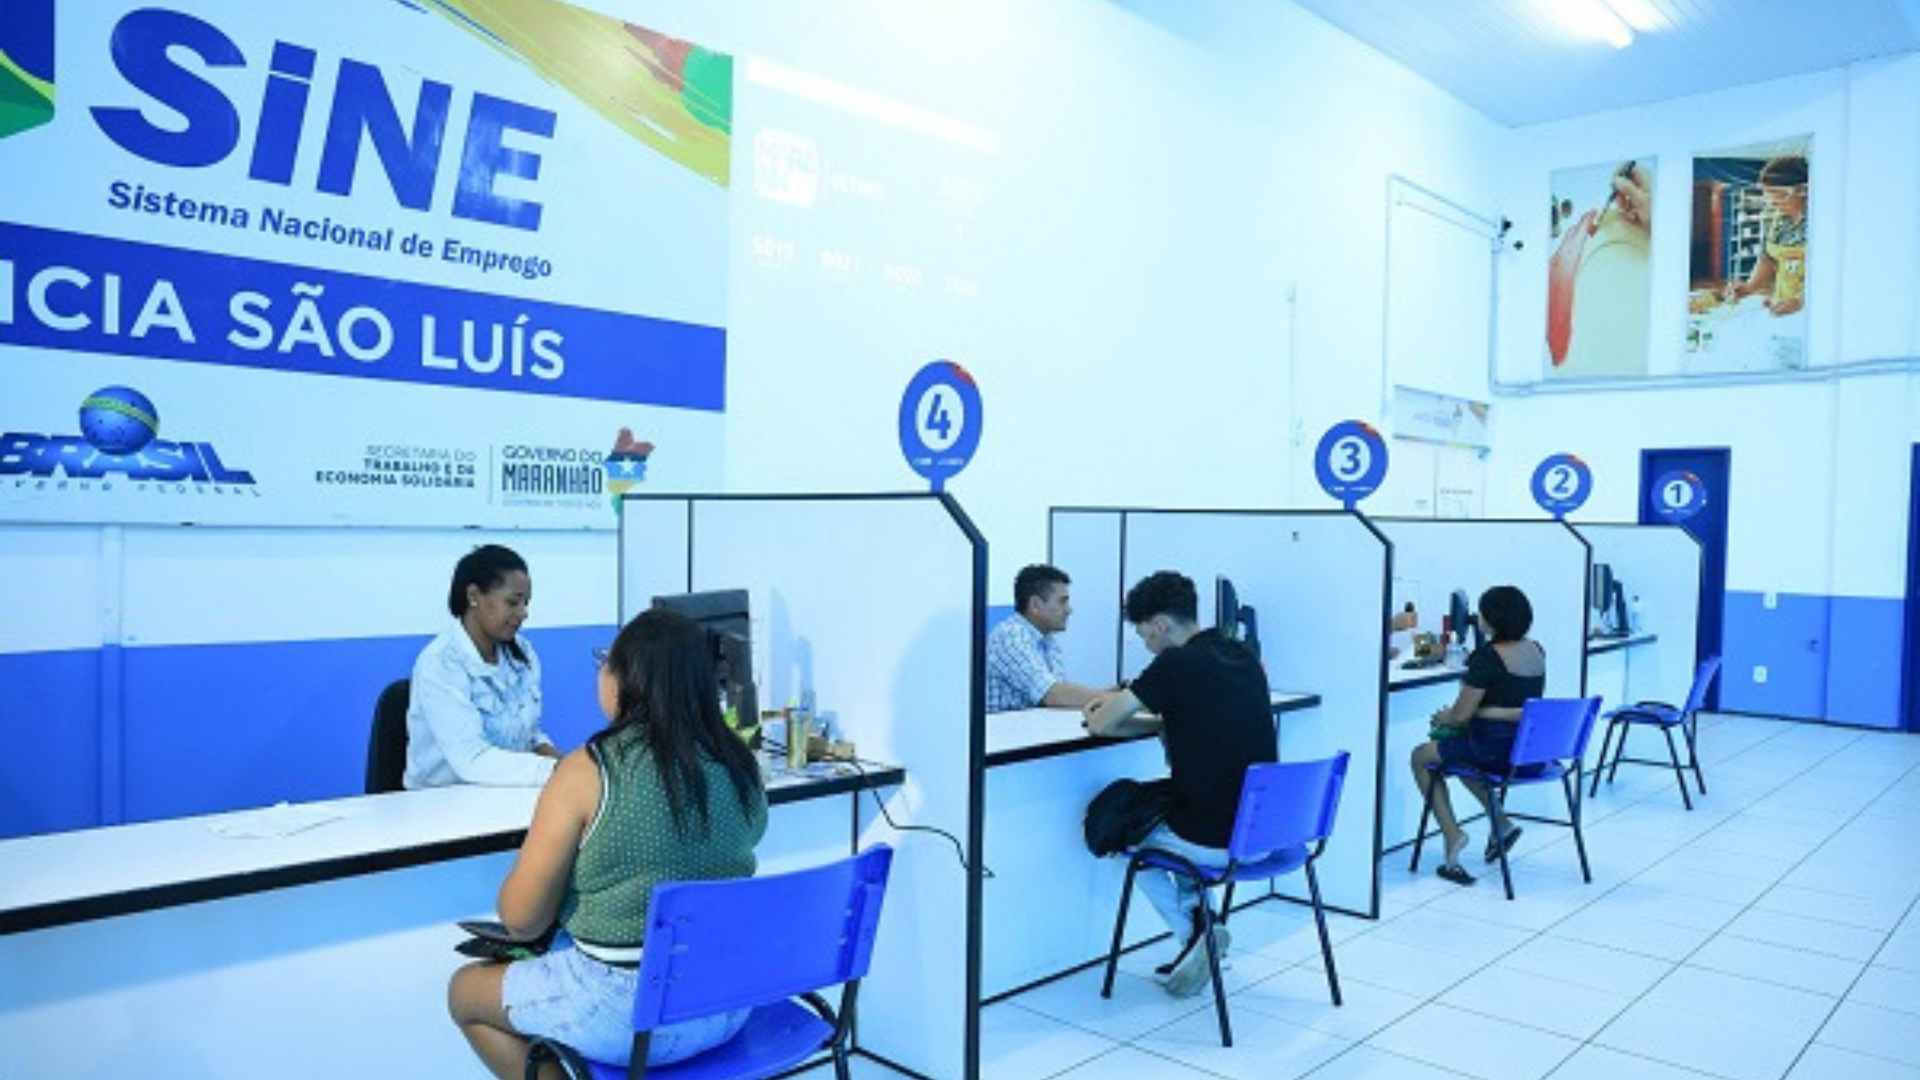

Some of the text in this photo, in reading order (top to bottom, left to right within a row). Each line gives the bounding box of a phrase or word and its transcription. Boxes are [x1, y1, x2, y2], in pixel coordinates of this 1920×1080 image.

[108, 181, 552, 279] Sistema Nacional de Emprego
[0, 259, 564, 379] CIA SÃO LUÍS
[926, 393, 951, 440] 4
[0, 431, 257, 485] BRASIL
[502, 444, 577, 462] GOVERNO
[1340, 441, 1361, 475] 3
[315, 470, 397, 486] ECONOMIA
[444, 463, 453, 475] E
[1552, 468, 1570, 494] 2
[1669, 483, 1682, 504] 1
